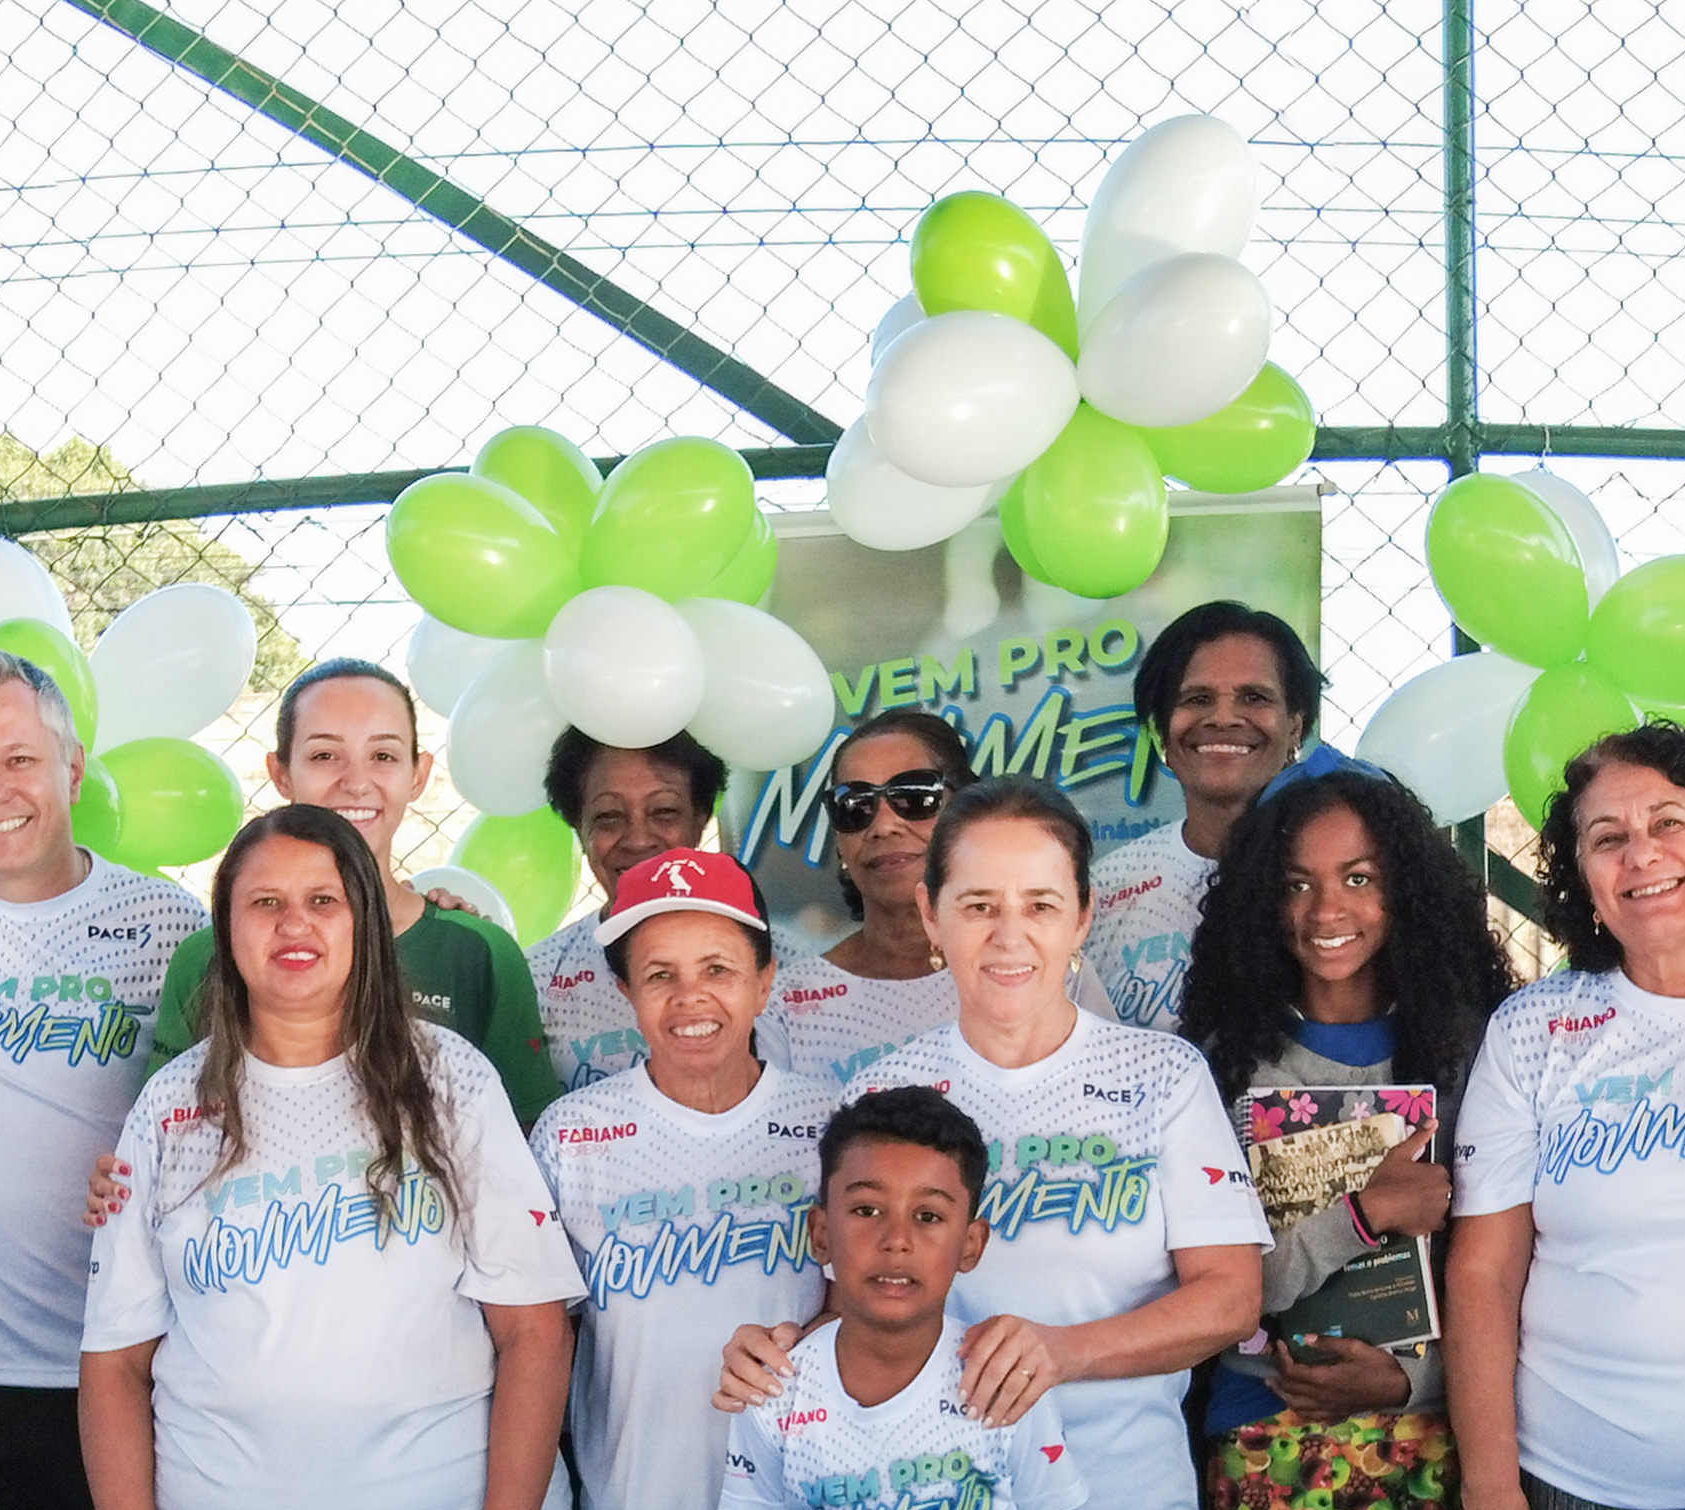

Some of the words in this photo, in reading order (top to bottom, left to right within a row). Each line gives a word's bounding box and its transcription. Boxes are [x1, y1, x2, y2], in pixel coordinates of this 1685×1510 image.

[831, 646, 978, 716] VEM
[998, 618, 1139, 687] PRO
[29, 975, 113, 1004] PRO
[1575, 1065, 1672, 1110] VEM
[557, 1122, 638, 1145] FABIANO
[1014, 1133, 1117, 1170] PRO
[205, 1163, 303, 1216] VEM
[599, 1193, 694, 1229] VEM
[707, 1173, 803, 1209] PRO
[799, 1467, 882, 1507] VEM
[890, 1450, 970, 1490] PRO
